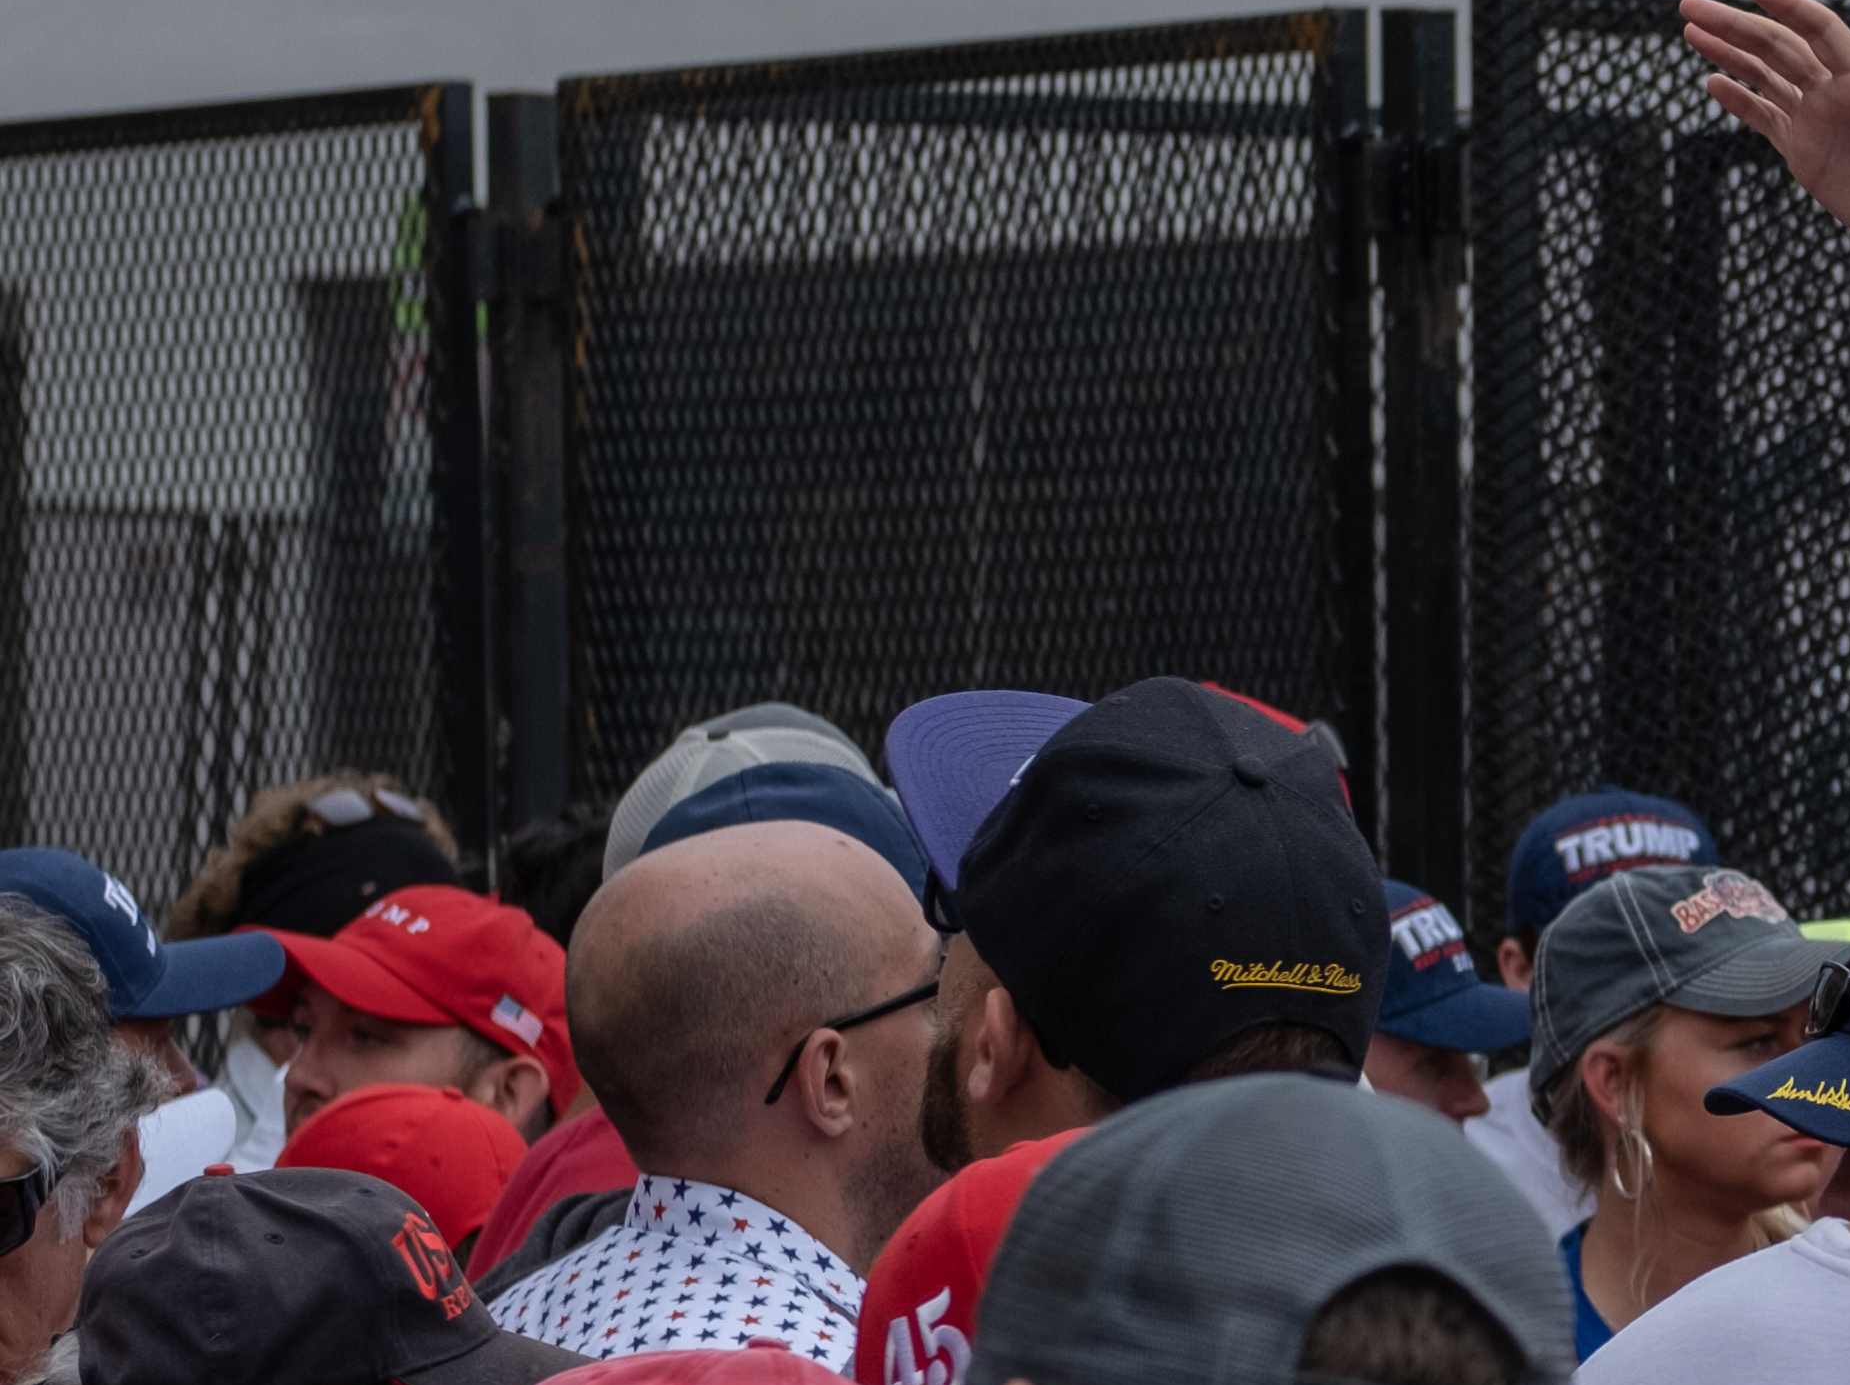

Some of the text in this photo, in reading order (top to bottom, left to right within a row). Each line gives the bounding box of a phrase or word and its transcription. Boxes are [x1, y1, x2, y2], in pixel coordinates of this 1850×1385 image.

[1556, 820, 1700, 874] TRUMP
[1210, 959, 1362, 989] Mitchell & Ness
